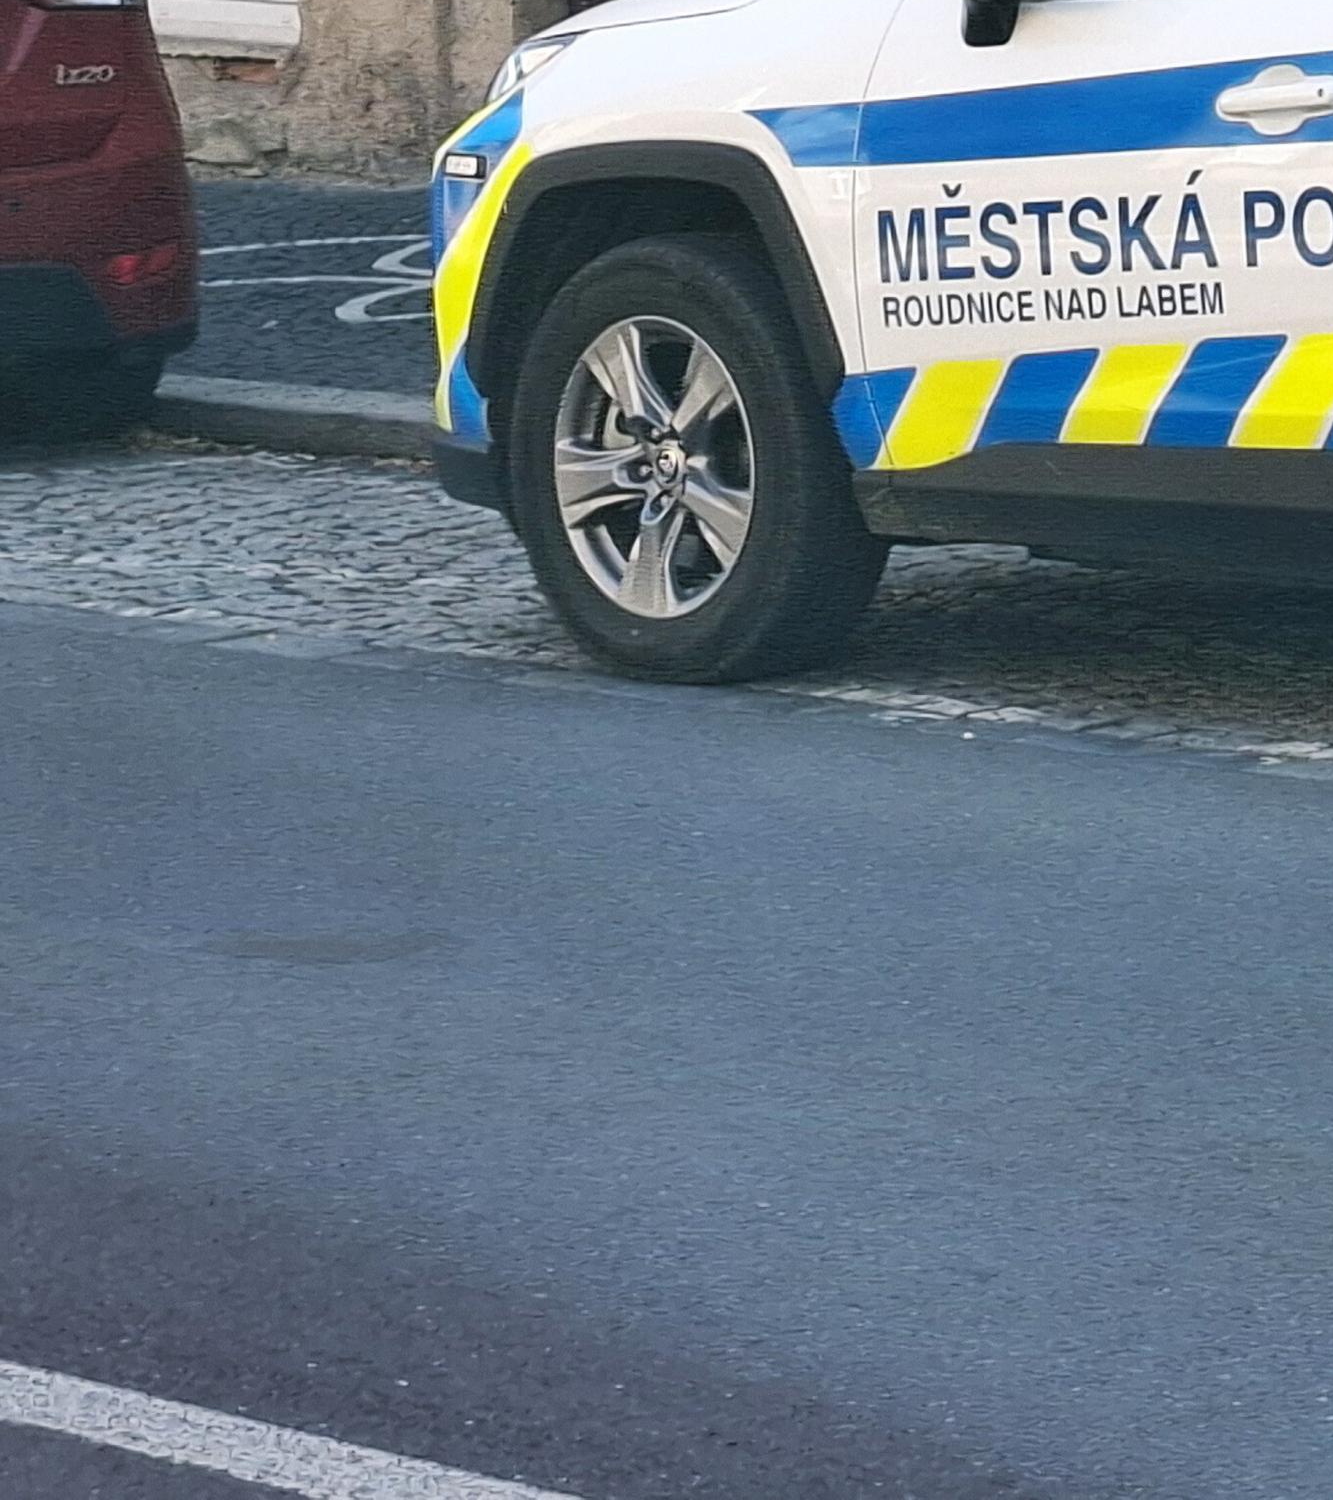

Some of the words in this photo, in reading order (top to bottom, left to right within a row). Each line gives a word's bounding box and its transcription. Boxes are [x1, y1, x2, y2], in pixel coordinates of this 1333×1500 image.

[877, 169, 1220, 284] MĚSTSKÁ
[882, 290, 1036, 329] ROUDNICE
[1043, 287, 1108, 322] NAD
[1115, 282, 1226, 319] LABEM
